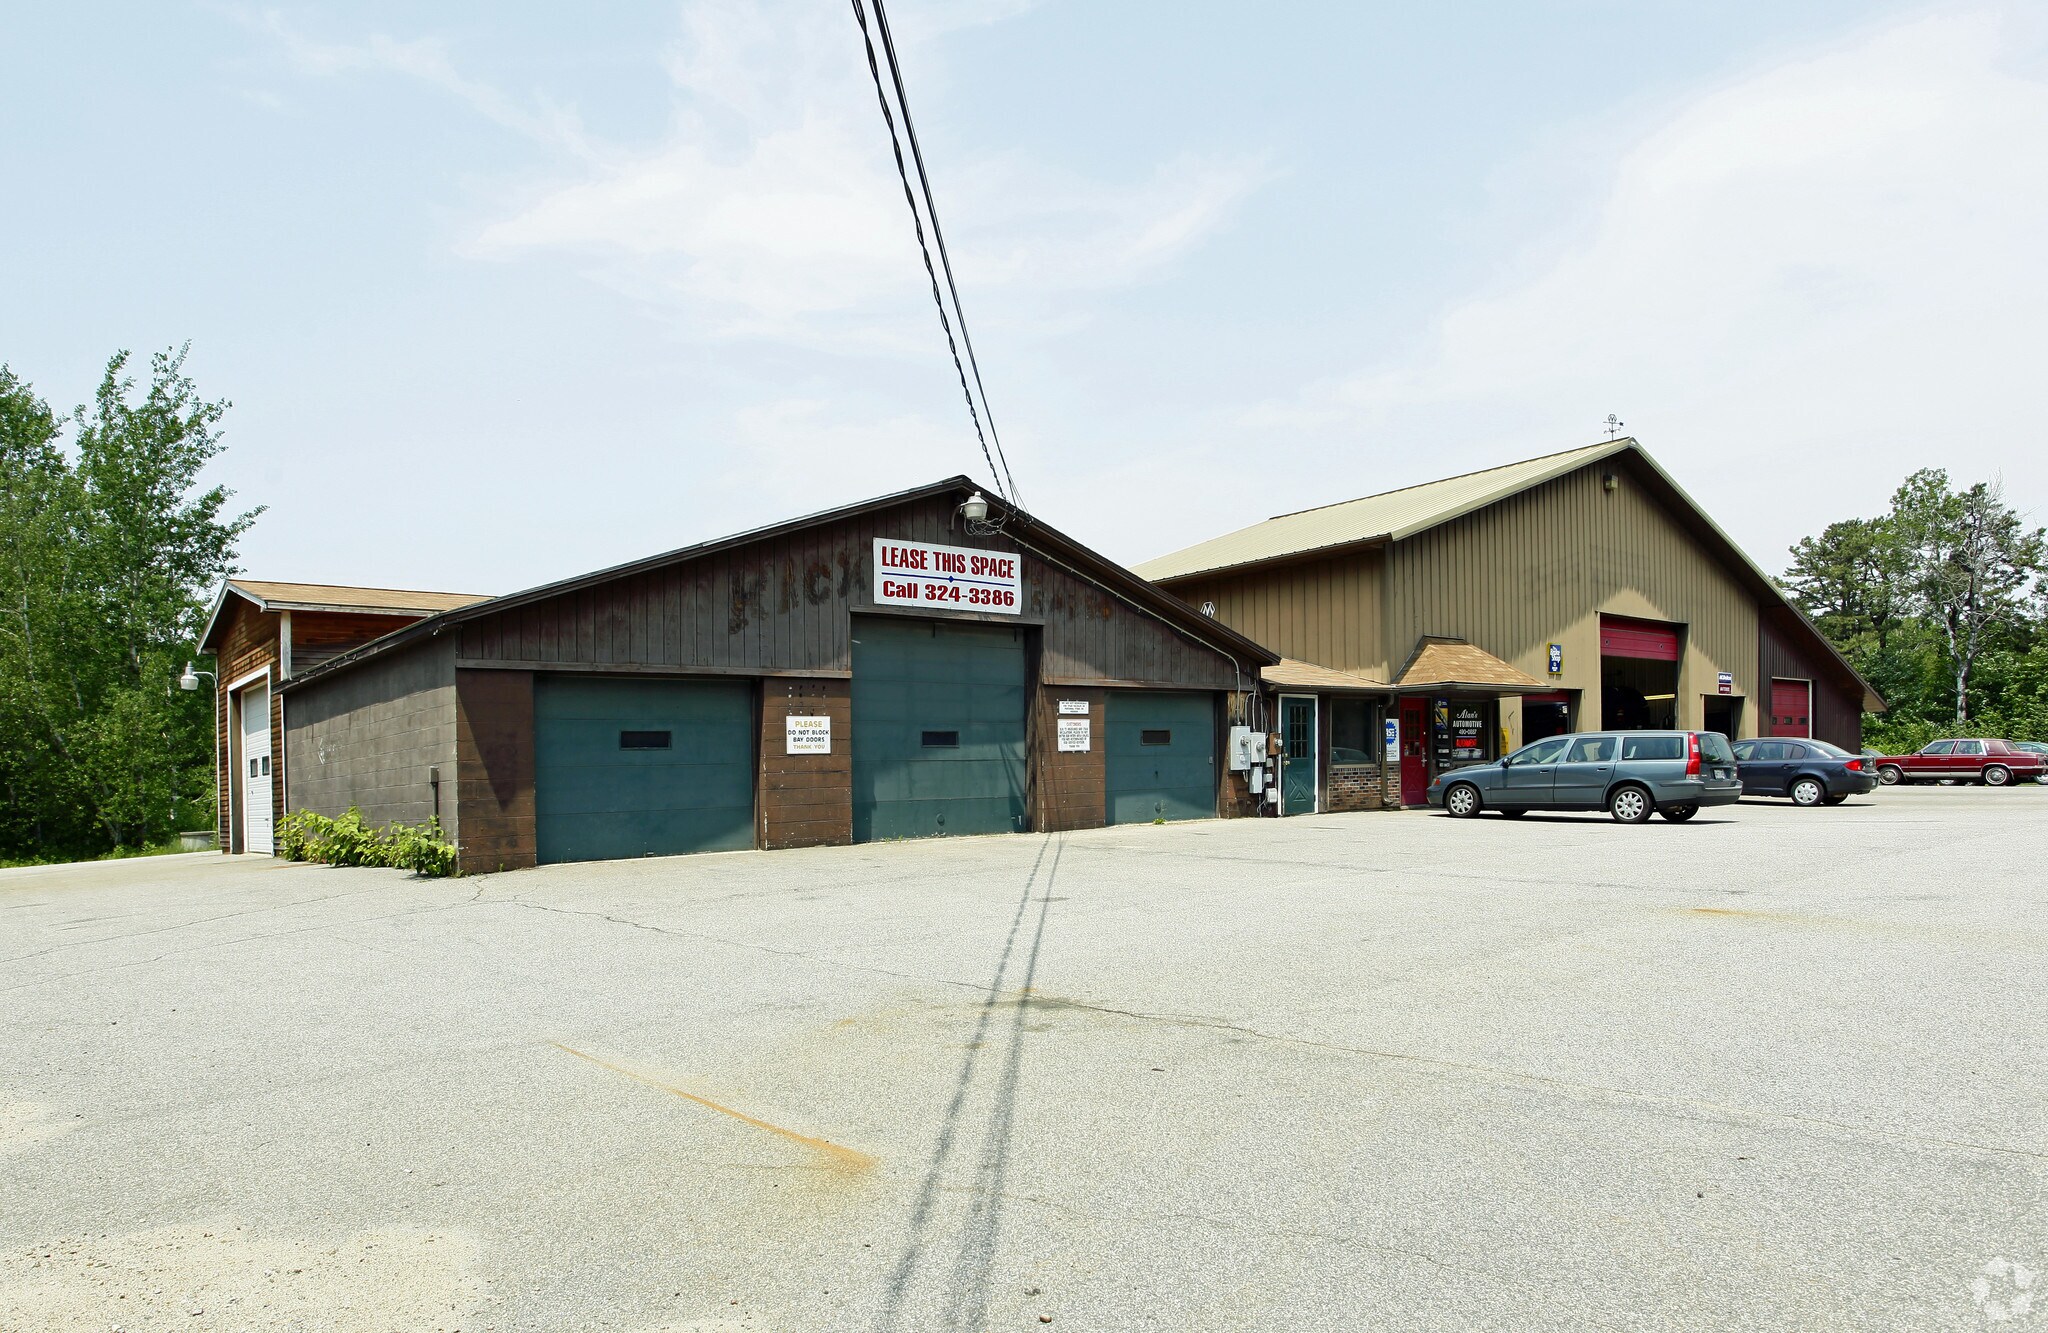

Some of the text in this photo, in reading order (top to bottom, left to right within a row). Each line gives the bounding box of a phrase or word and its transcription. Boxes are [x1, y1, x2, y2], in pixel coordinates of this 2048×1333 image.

[881, 546, 1015, 579] LEASE THIS SPACE
[883, 580, 1015, 607] Call 324-3386
[1456, 709, 1478, 719] Alan's
[795, 720, 823, 728] PLEASE
[1453, 720, 1482, 728] AUTOMOTIVE
